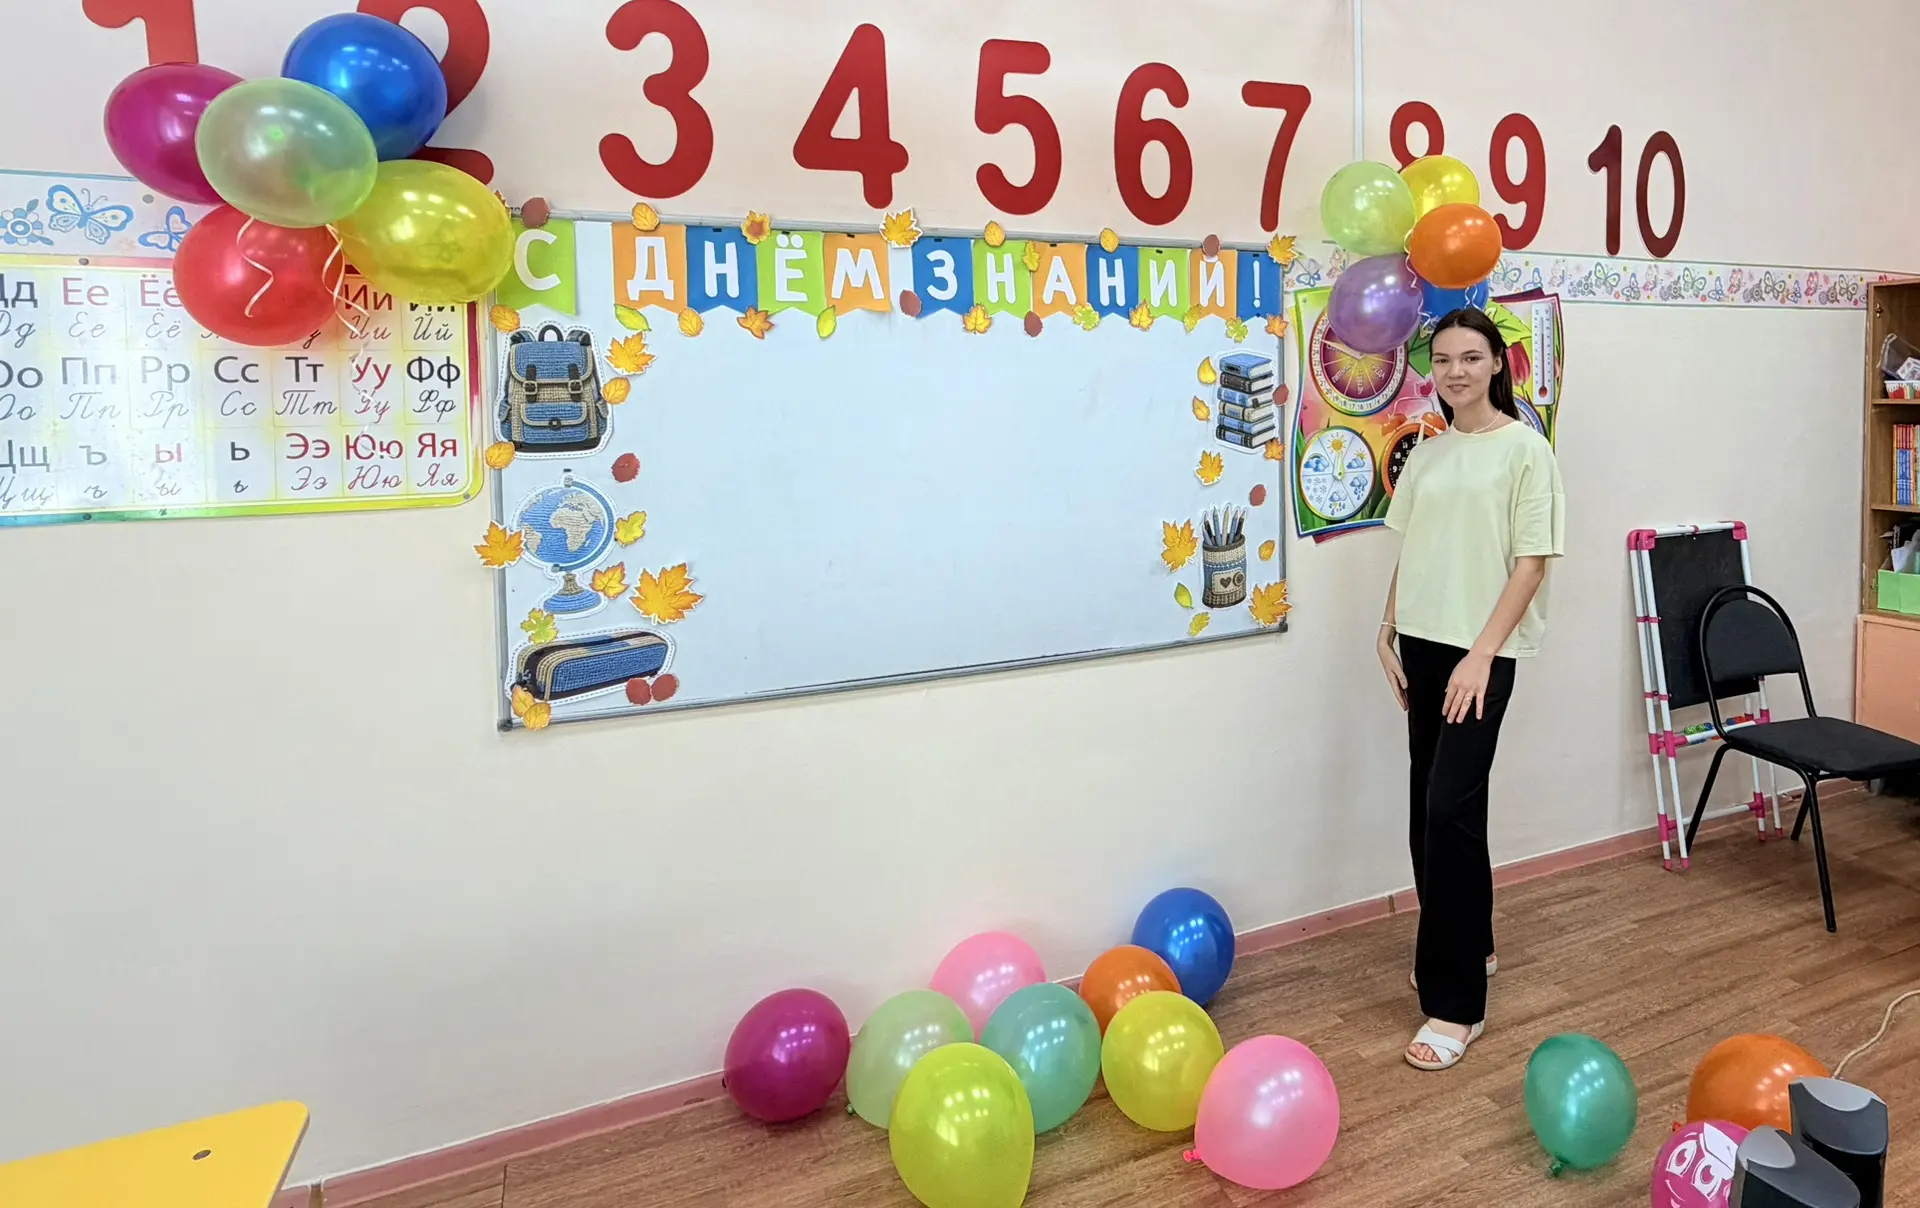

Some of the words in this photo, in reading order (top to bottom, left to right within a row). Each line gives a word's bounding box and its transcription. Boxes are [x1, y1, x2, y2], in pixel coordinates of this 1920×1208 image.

[599, 0, 714, 199] 3
[793, 23, 909, 209] 4
[975, 38, 1062, 215] 5
[1114, 62, 1193, 226] 6
[1241, 80, 1311, 232] 7
[1489, 113, 1546, 250] 9
[1587, 124, 1686, 258] 10
[514, 229, 561, 291] С
[627, 234, 885, 302] ДНЁМ
[926, 250, 1261, 309] ЗНАНИЙ!
[0, 273, 38, 308] д
[62, 277, 109, 306] Ее
[344, 284, 392, 311] Ии
[61, 357, 116, 385] Пп
[141, 356, 190, 391] Рр
[214, 356, 259, 383] Сс
[285, 356, 324, 383] Тт
[350, 356, 392, 390] Уу
[406, 356, 460, 388] Фф
[286, 433, 330, 460] Ээ
[345, 433, 404, 460] Юю
[417, 433, 457, 459] Яя
